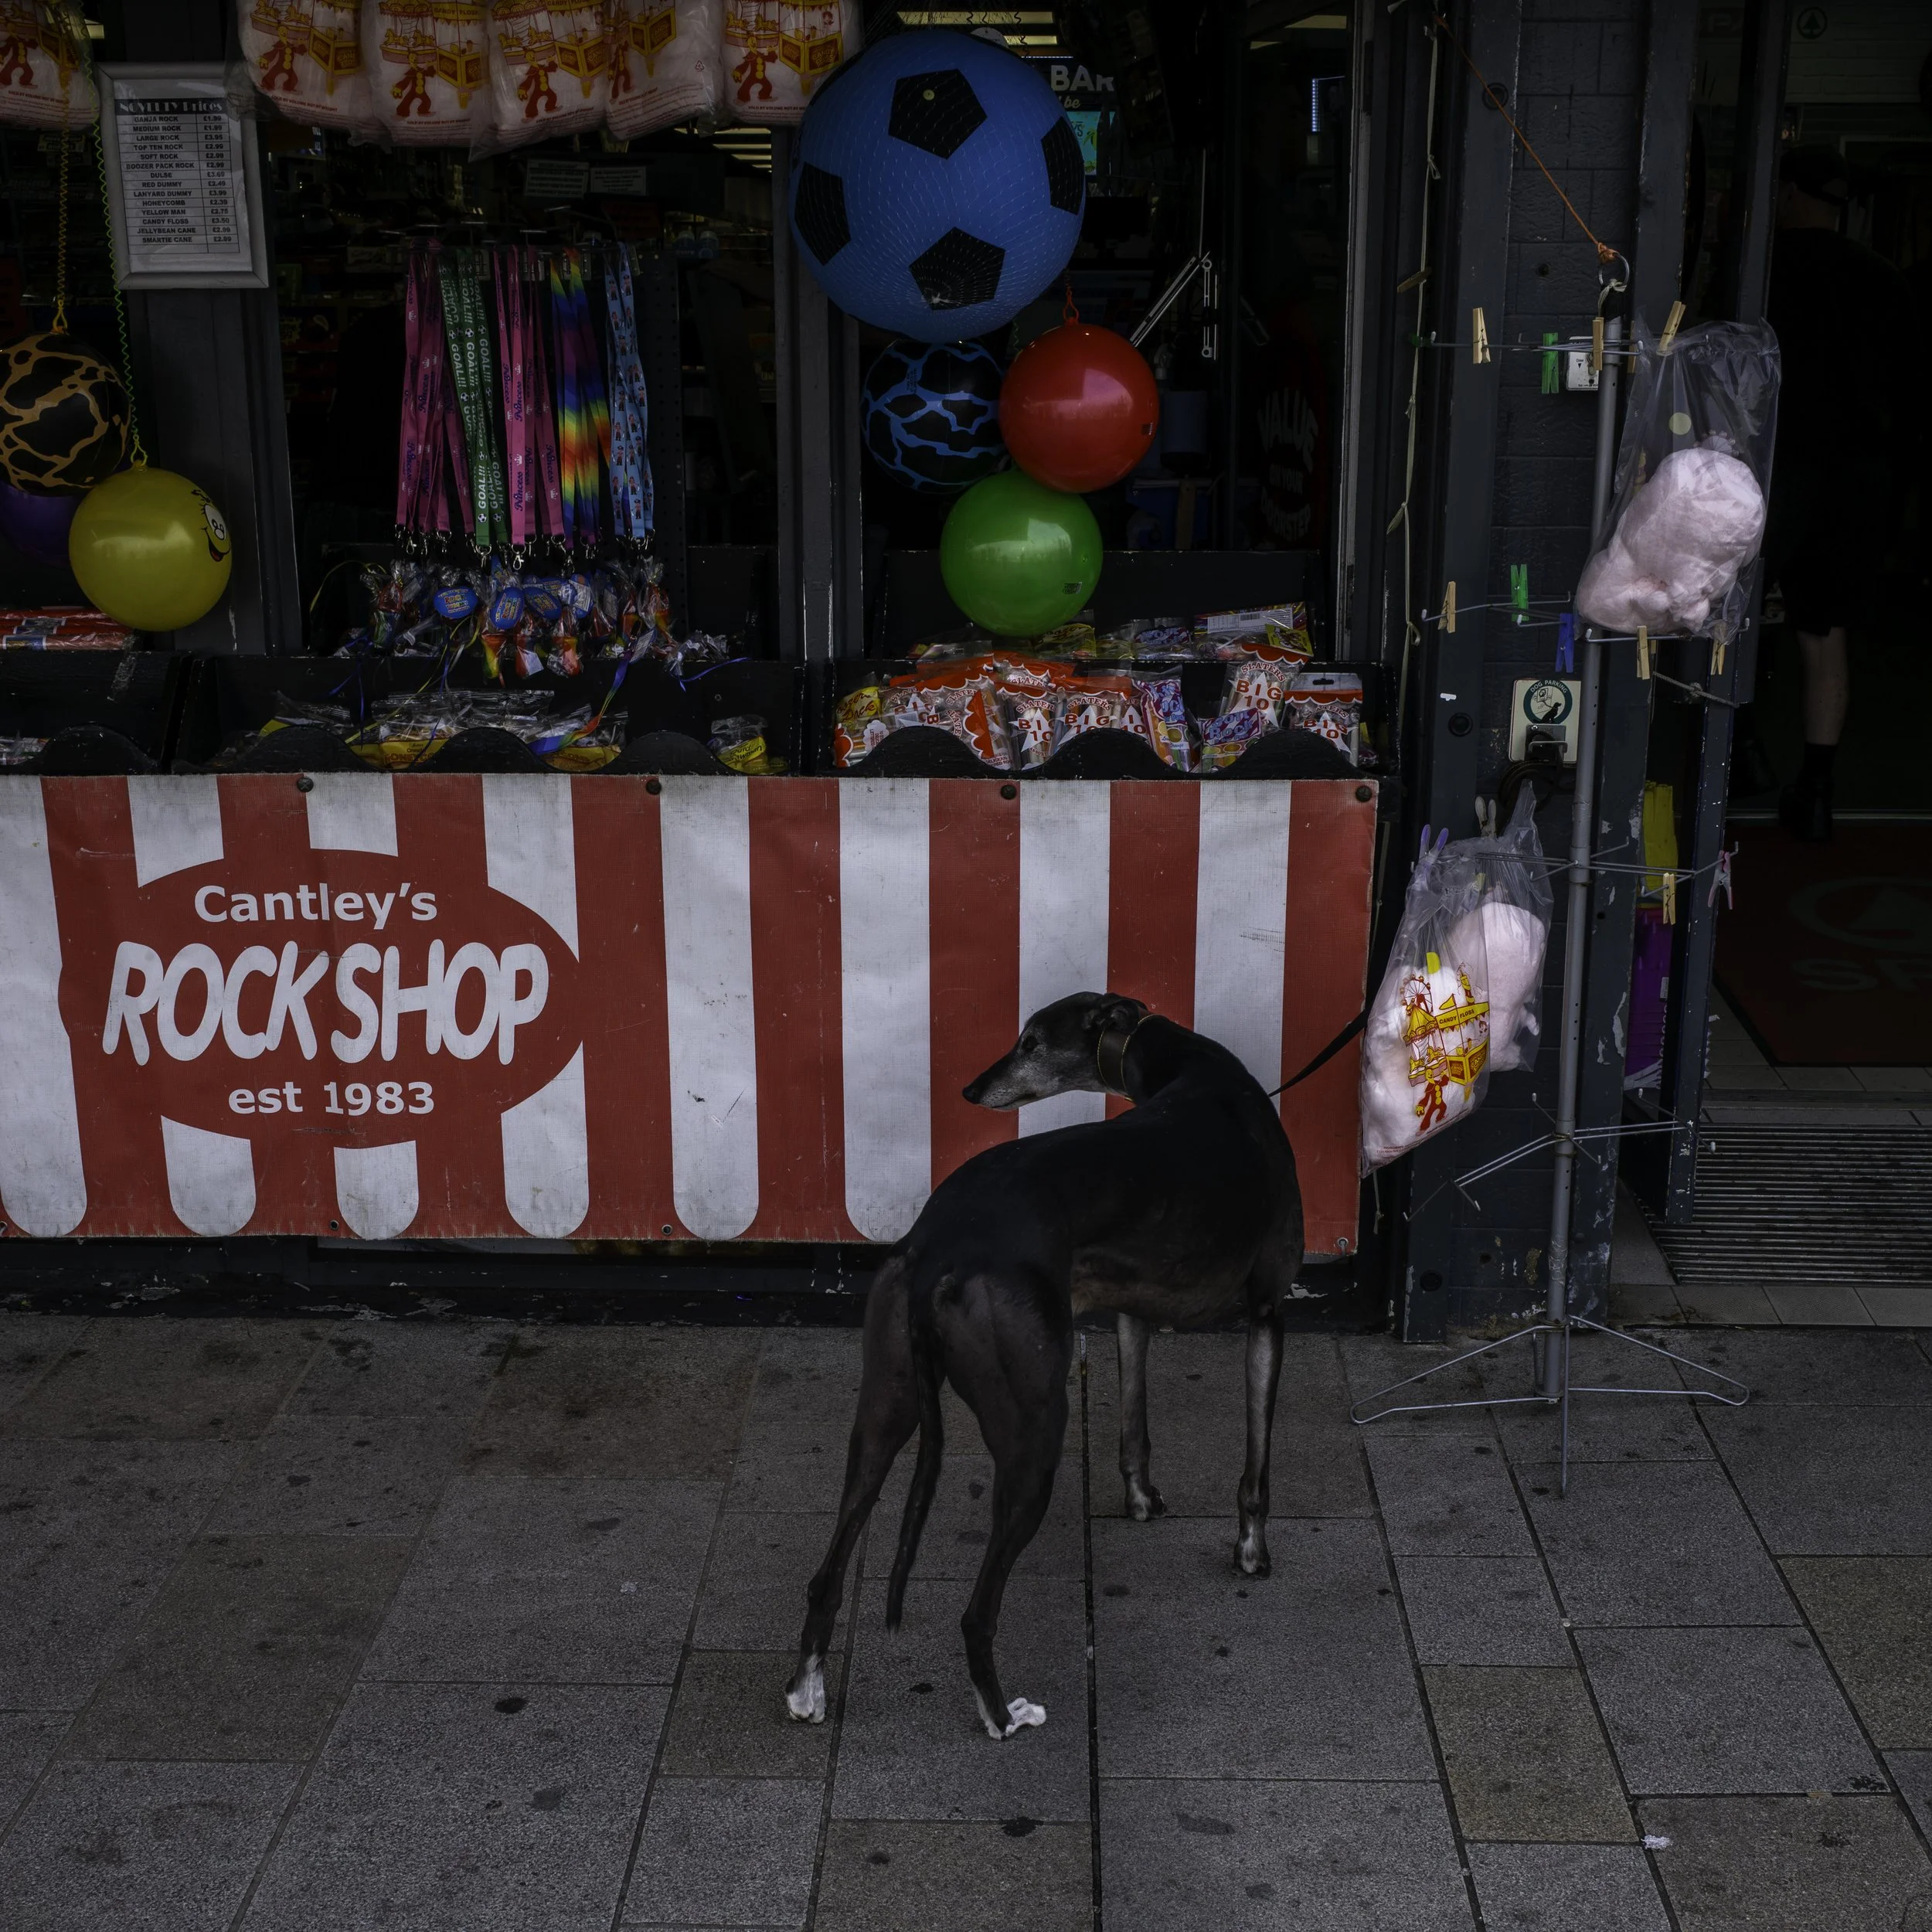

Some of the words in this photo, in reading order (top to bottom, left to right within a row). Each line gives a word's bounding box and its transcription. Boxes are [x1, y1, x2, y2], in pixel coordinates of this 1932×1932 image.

[120, 100, 179, 113] NOVELTY
[182, 100, 223, 112] Prices
[451, 342, 468, 388] GOAL!!!
[466, 342, 475, 387] GOAL!!!
[478, 338, 492, 383] GOAL!!!
[513, 380, 523, 422] Princess
[478, 464, 487, 509] GOAL!!!
[514, 471, 524, 512] Princess
[1240, 662, 1286, 682] SLATERS
[1236, 679, 1283, 702] BIG
[1529, 681, 1544, 693] DOG
[1544, 679, 1568, 694] PARKING
[1015, 699, 1056, 714] SLATER
[1067, 696, 1114, 712] SLATERS
[1243, 695, 1270, 710] 10
[1064, 713, 1111, 726] BIG
[1303, 719, 1349, 735] BIG
[102, 940, 330, 1066] ROCK
[330, 938, 549, 1066] SHOP
[1439, 1015, 1458, 1025] CANDY
[228, 1080, 304, 1115] est
[324, 1080, 434, 1117] 1983
